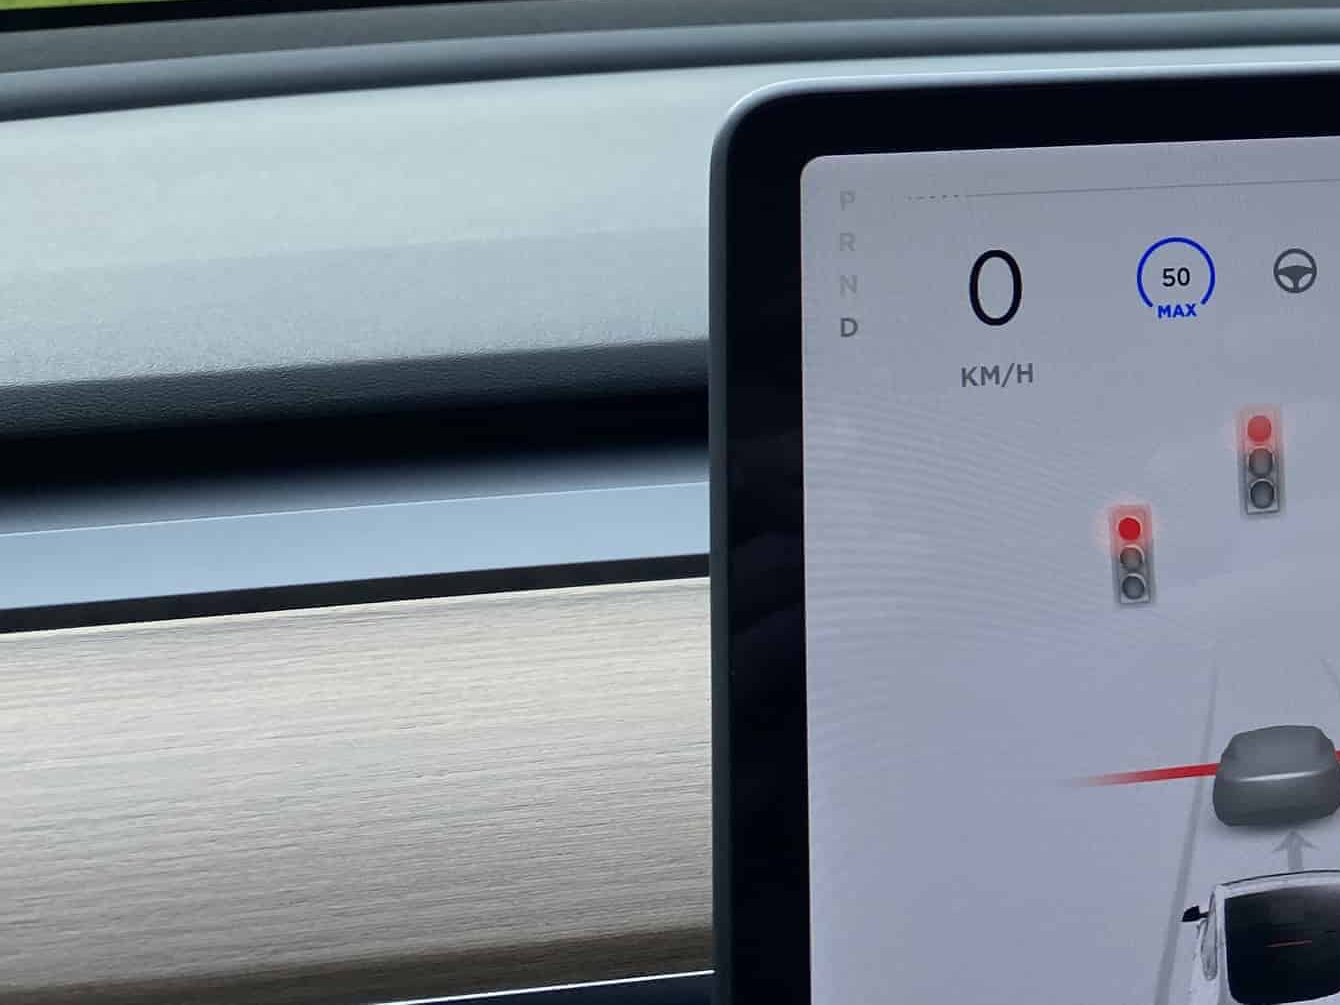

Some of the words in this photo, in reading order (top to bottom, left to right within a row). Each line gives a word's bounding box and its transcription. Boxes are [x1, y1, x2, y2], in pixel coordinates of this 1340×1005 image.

[839, 190, 855, 211] P
[839, 231, 856, 251] R
[839, 274, 858, 295] N
[1162, 266, 1191, 287] 50
[968, 248, 1023, 327] 0
[1157, 302, 1198, 319] MAX
[839, 317, 858, 338] D
[960, 362, 1034, 388] KM/H
